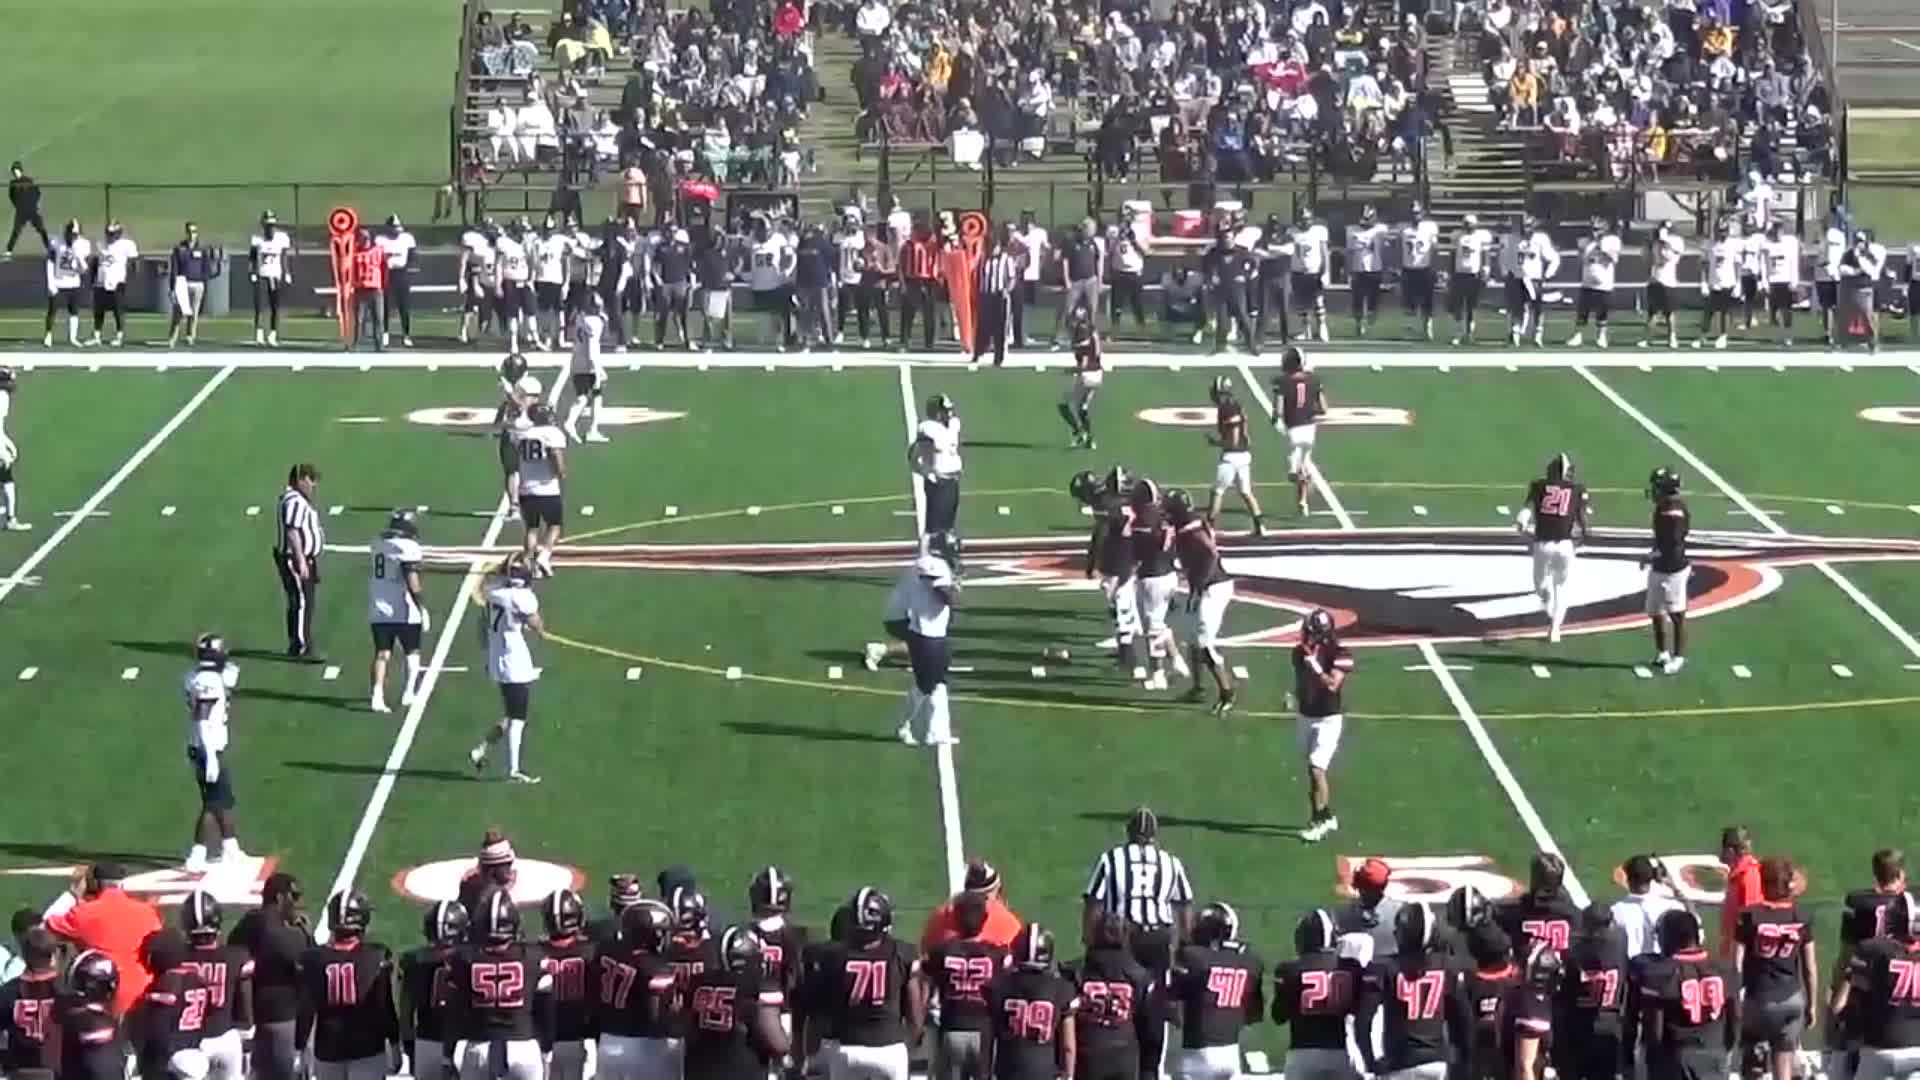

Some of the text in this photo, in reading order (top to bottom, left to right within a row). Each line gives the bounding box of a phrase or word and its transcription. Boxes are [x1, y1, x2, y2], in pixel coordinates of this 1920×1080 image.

[374, 552, 385, 579] 8
[325, 962, 358, 1004] 11
[471, 961, 525, 1007] 52
[846, 960, 887, 1006] 71
[1396, 970, 1444, 1019] 47
[1681, 975, 1725, 1024] 99
